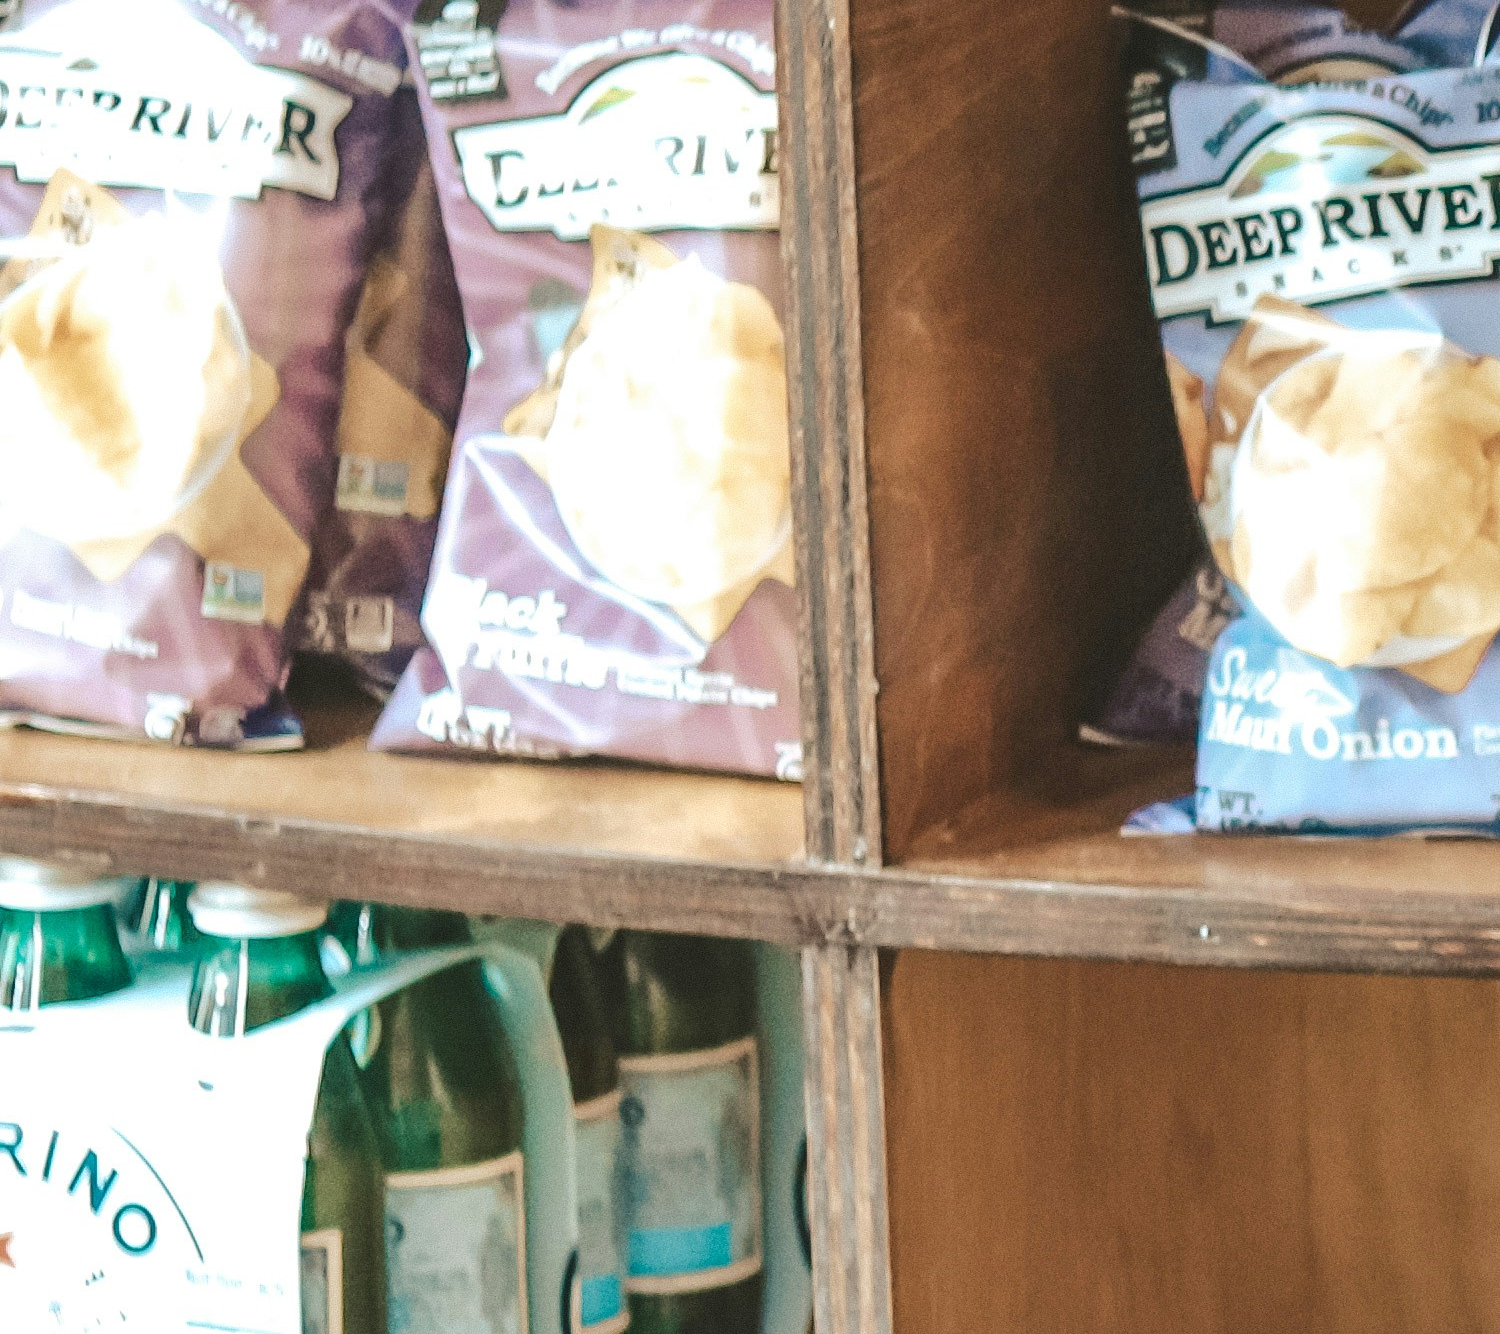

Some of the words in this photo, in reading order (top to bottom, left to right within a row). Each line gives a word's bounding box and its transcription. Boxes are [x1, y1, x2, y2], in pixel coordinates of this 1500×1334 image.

[1148, 204, 1306, 293] DEEP
[1302, 716, 1460, 761] Onion
[1217, 789, 1264, 816] WT.
